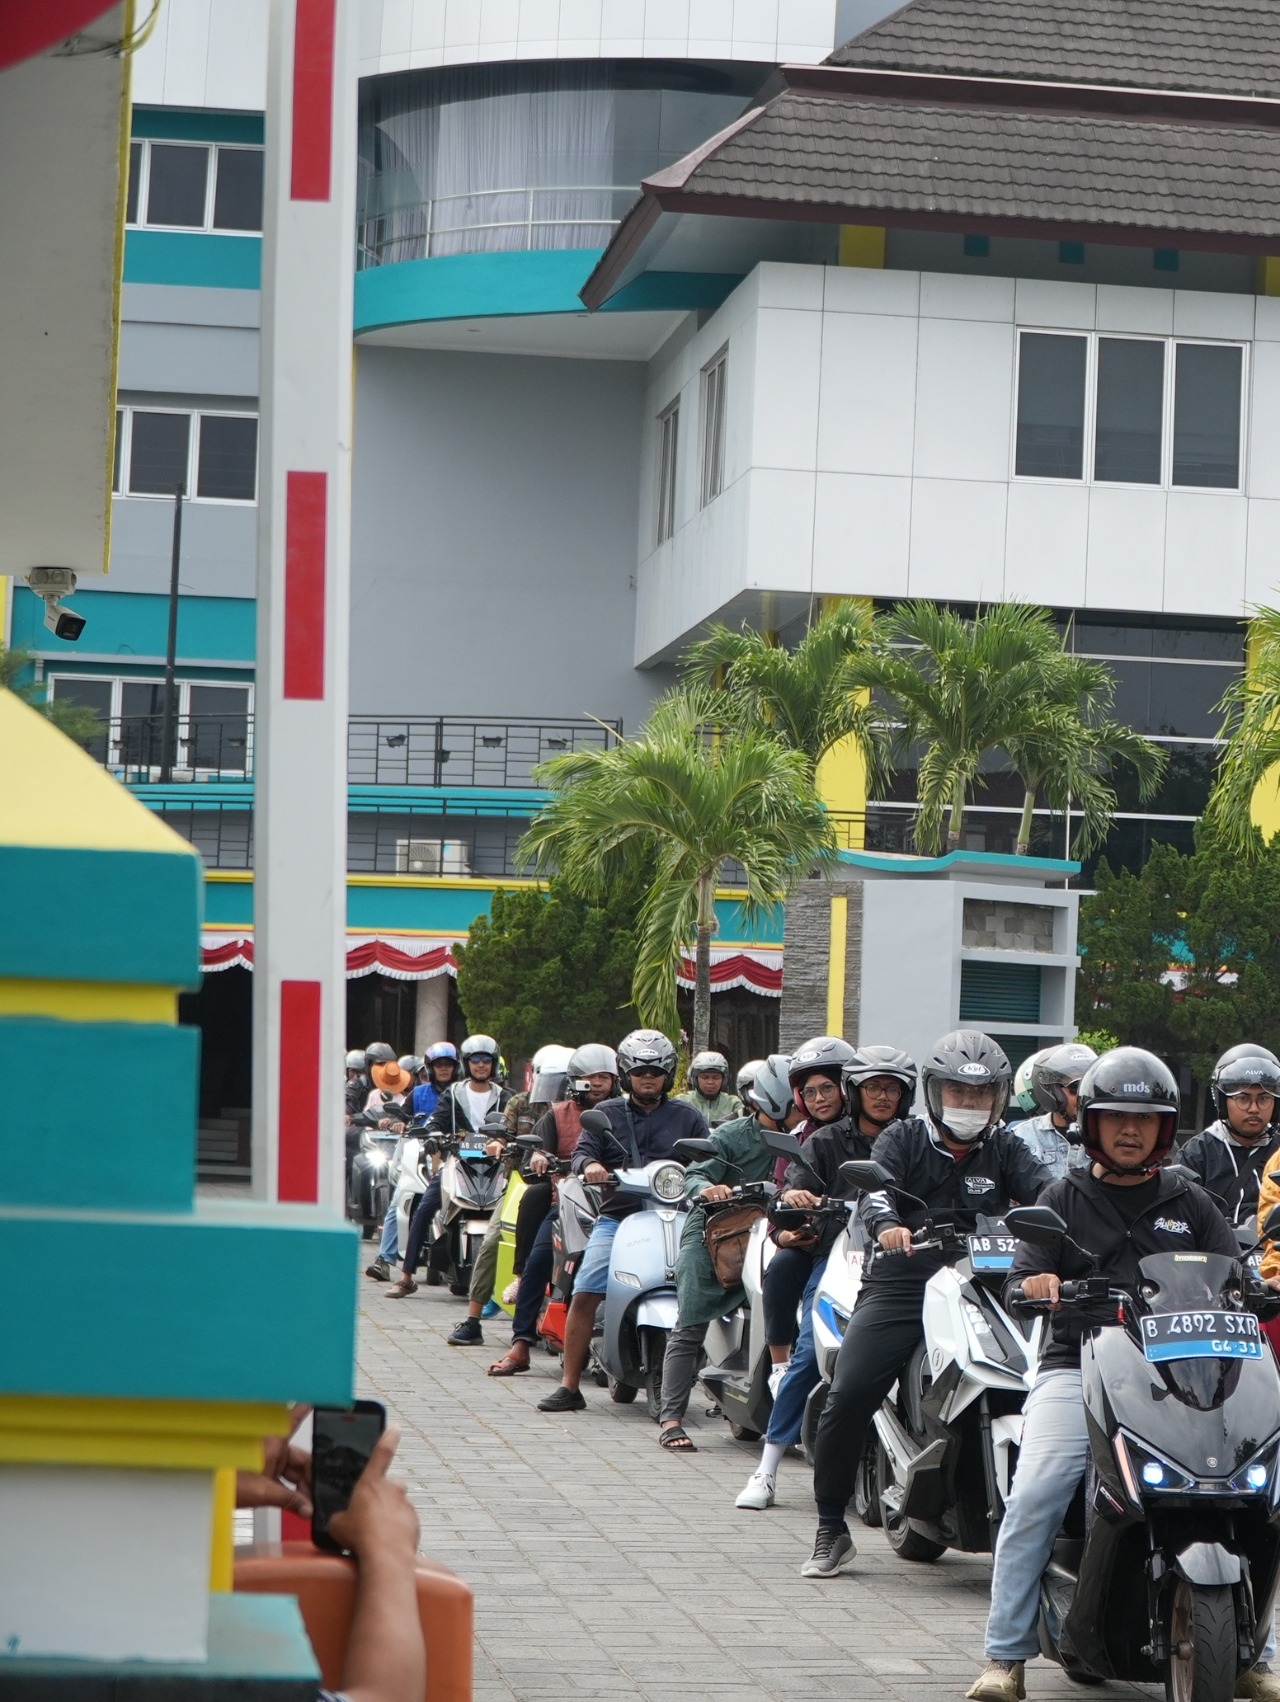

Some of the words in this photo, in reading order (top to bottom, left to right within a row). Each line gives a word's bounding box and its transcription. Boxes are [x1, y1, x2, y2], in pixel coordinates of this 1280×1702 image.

[1123, 1082, 1151, 1094] mds
[973, 1238, 991, 1252] AB
[996, 1238, 1020, 1252] 52
[1146, 1320, 1159, 1338] B
[1167, 1314, 1217, 1335] 4892
[1224, 1315, 1258, 1337] SXR
